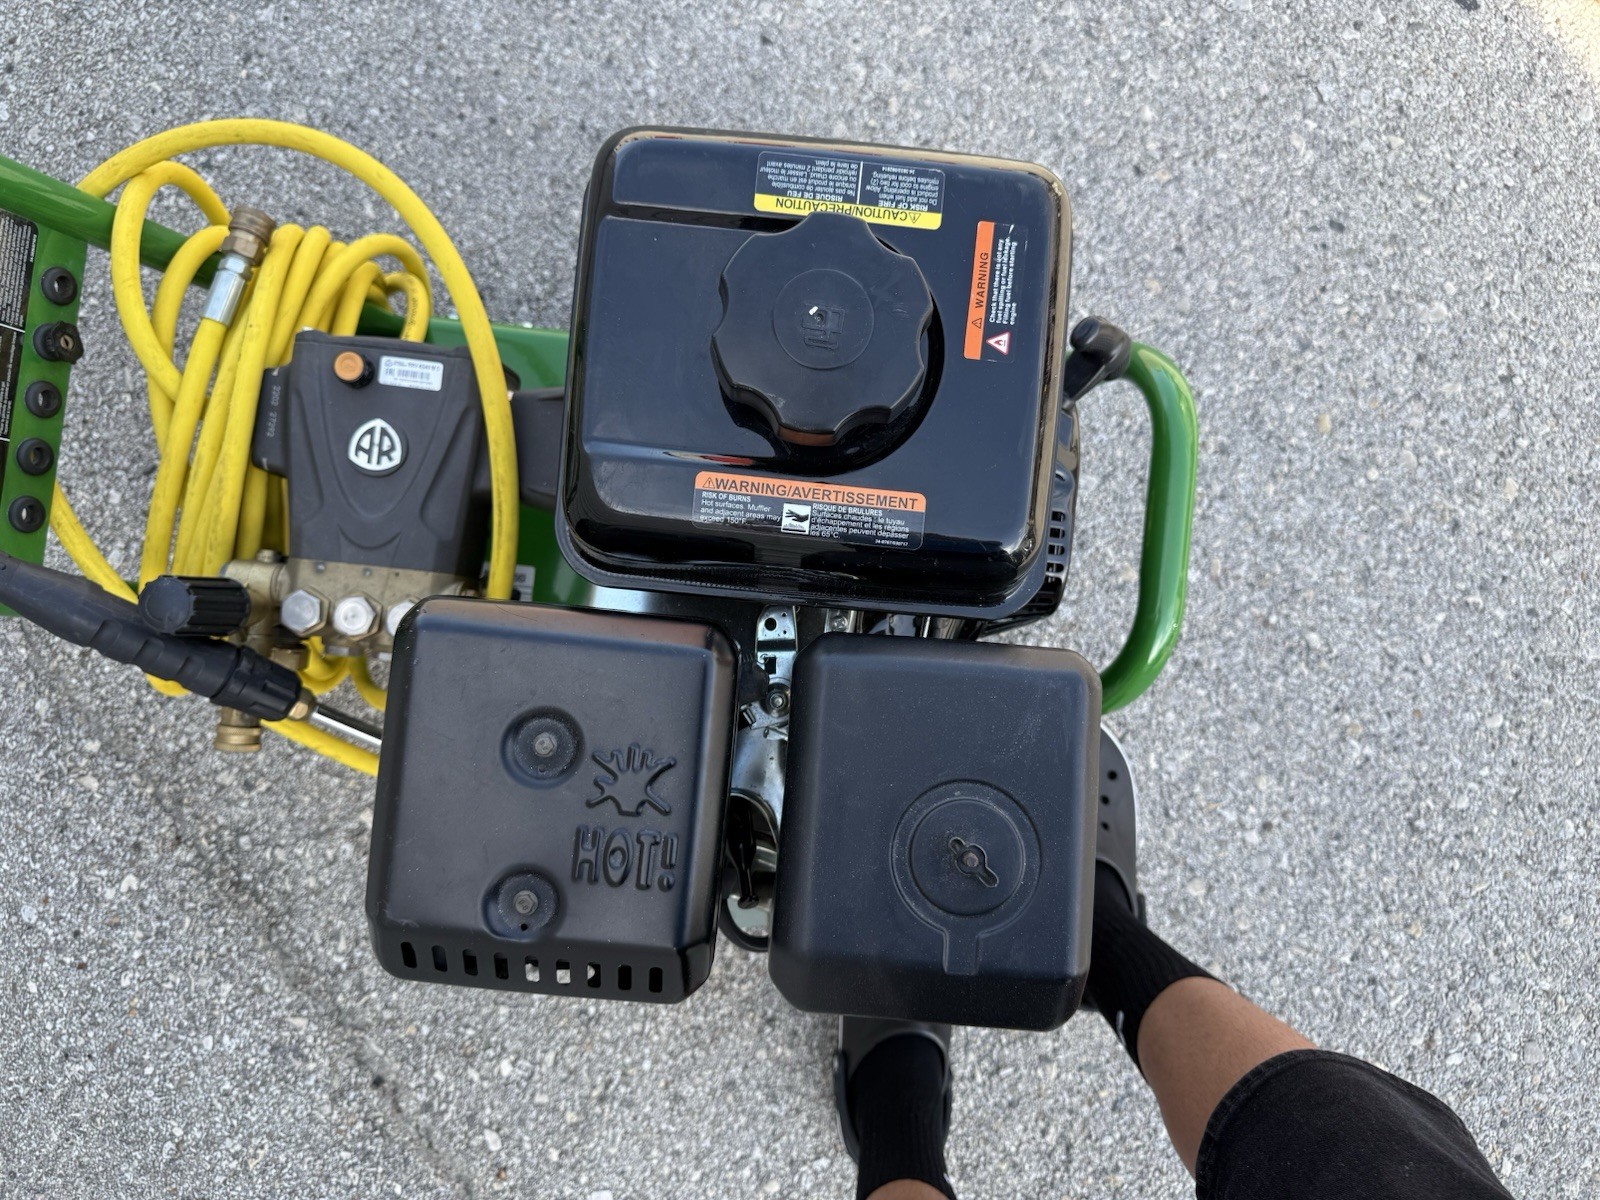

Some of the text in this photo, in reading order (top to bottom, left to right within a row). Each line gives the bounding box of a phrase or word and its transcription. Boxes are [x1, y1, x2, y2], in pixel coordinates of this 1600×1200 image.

[783, 162, 805, 170] minutes
[811, 164, 834, 173] pendant
[771, 181, 805, 190] combustible
[814, 185, 834, 193] ajouter
[815, 192, 842, 201] RISQUE
[878, 199, 895, 207] FIRE
[775, 198, 907, 221] CAUTION/PRECAUTION
[1009, 241, 1017, 266] starting
[974, 251, 989, 308] WARNING
[997, 285, 1005, 309] spilling
[1009, 302, 1017, 325] engine
[355, 426, 396, 466] AR
[714, 477, 918, 509] WARNING/AVERTISSEMENT
[728, 494, 751, 502] BURNS
[714, 508, 744, 518] adjacent
[747, 503, 771, 512] Muffler
[812, 502, 836, 511] RISQUE
[848, 506, 882, 516] BRULURES
[699, 514, 724, 523] exceed
[810, 516, 862, 528] d'échappement
[883, 524, 909, 533] régions
[811, 510, 842, 518] Surfaces
[843, 513, 872, 522] chaudes
[885, 517, 904, 526] tuyau
[810, 523, 909, 540] adjacentes peuvent dépasser
